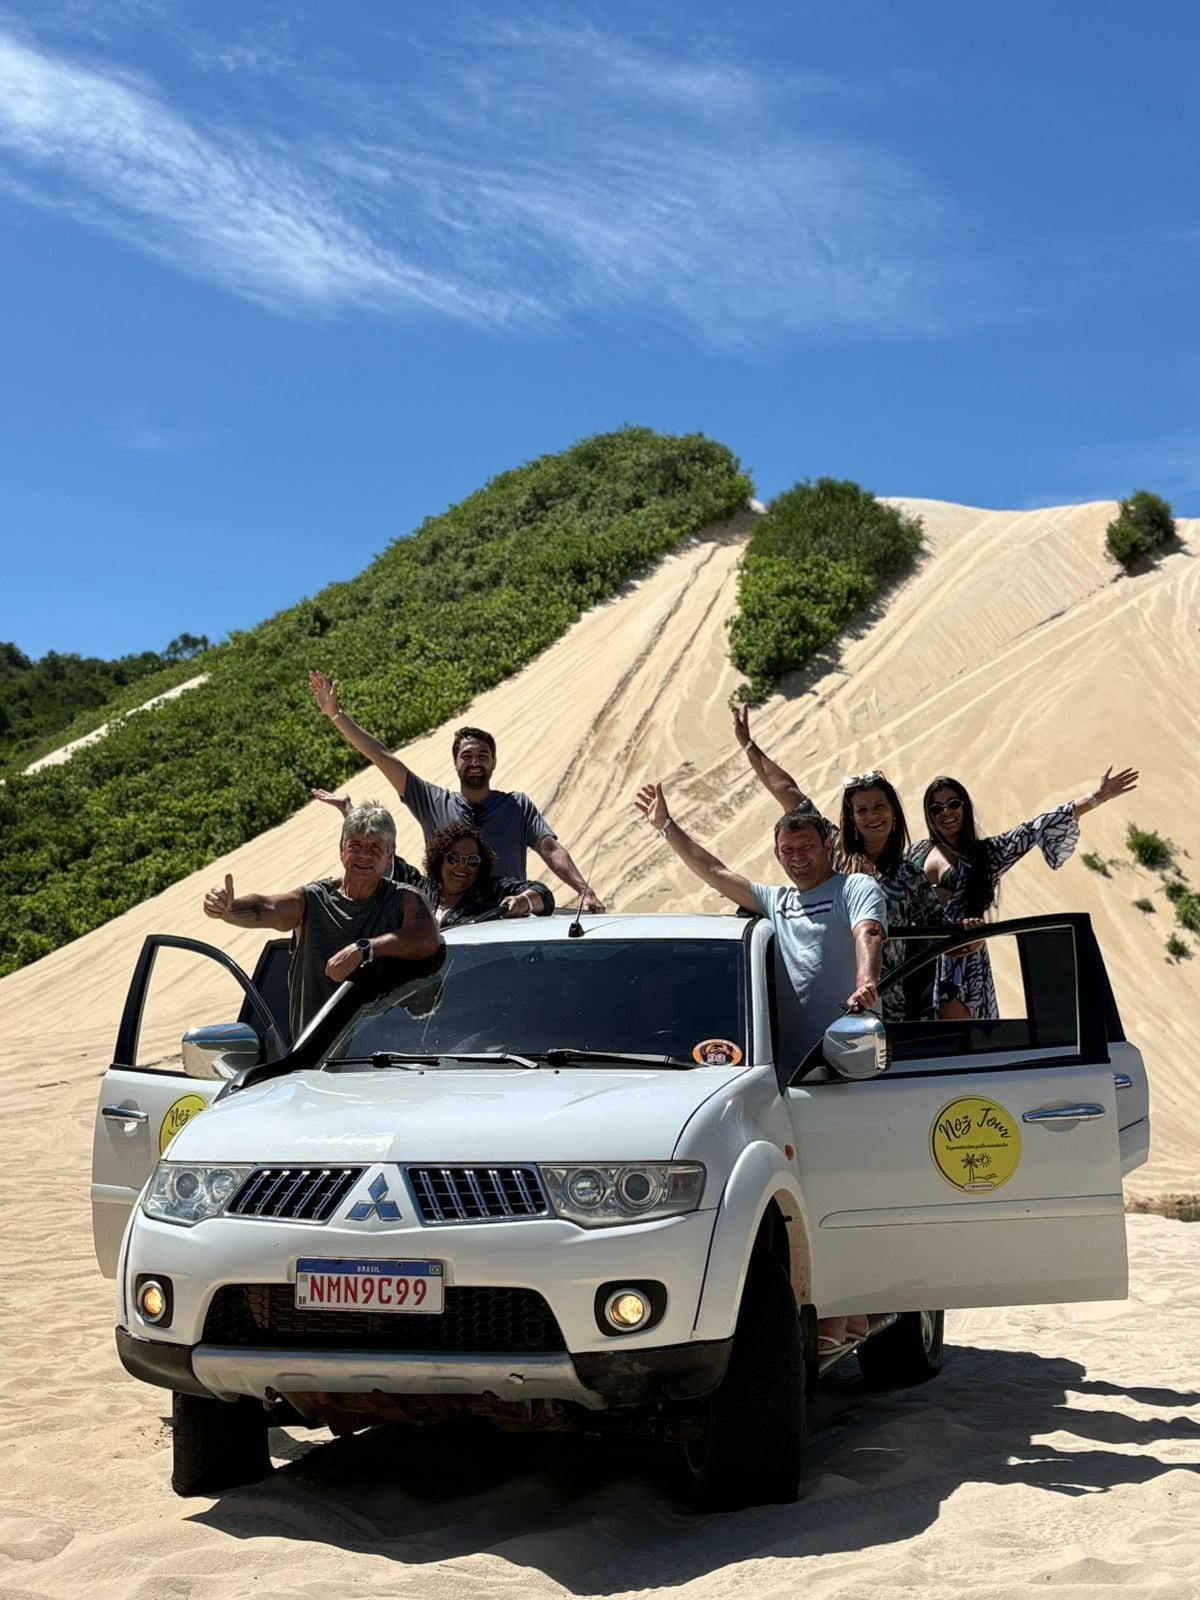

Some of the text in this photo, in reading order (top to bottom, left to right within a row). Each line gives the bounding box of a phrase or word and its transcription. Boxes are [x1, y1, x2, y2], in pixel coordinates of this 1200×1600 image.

[976, 1107, 1011, 1139] Tour
[356, 1265, 381, 1274] BRASIL
[298, 1295, 307, 1305] BR
[310, 1275, 427, 1306] NMN9C99
